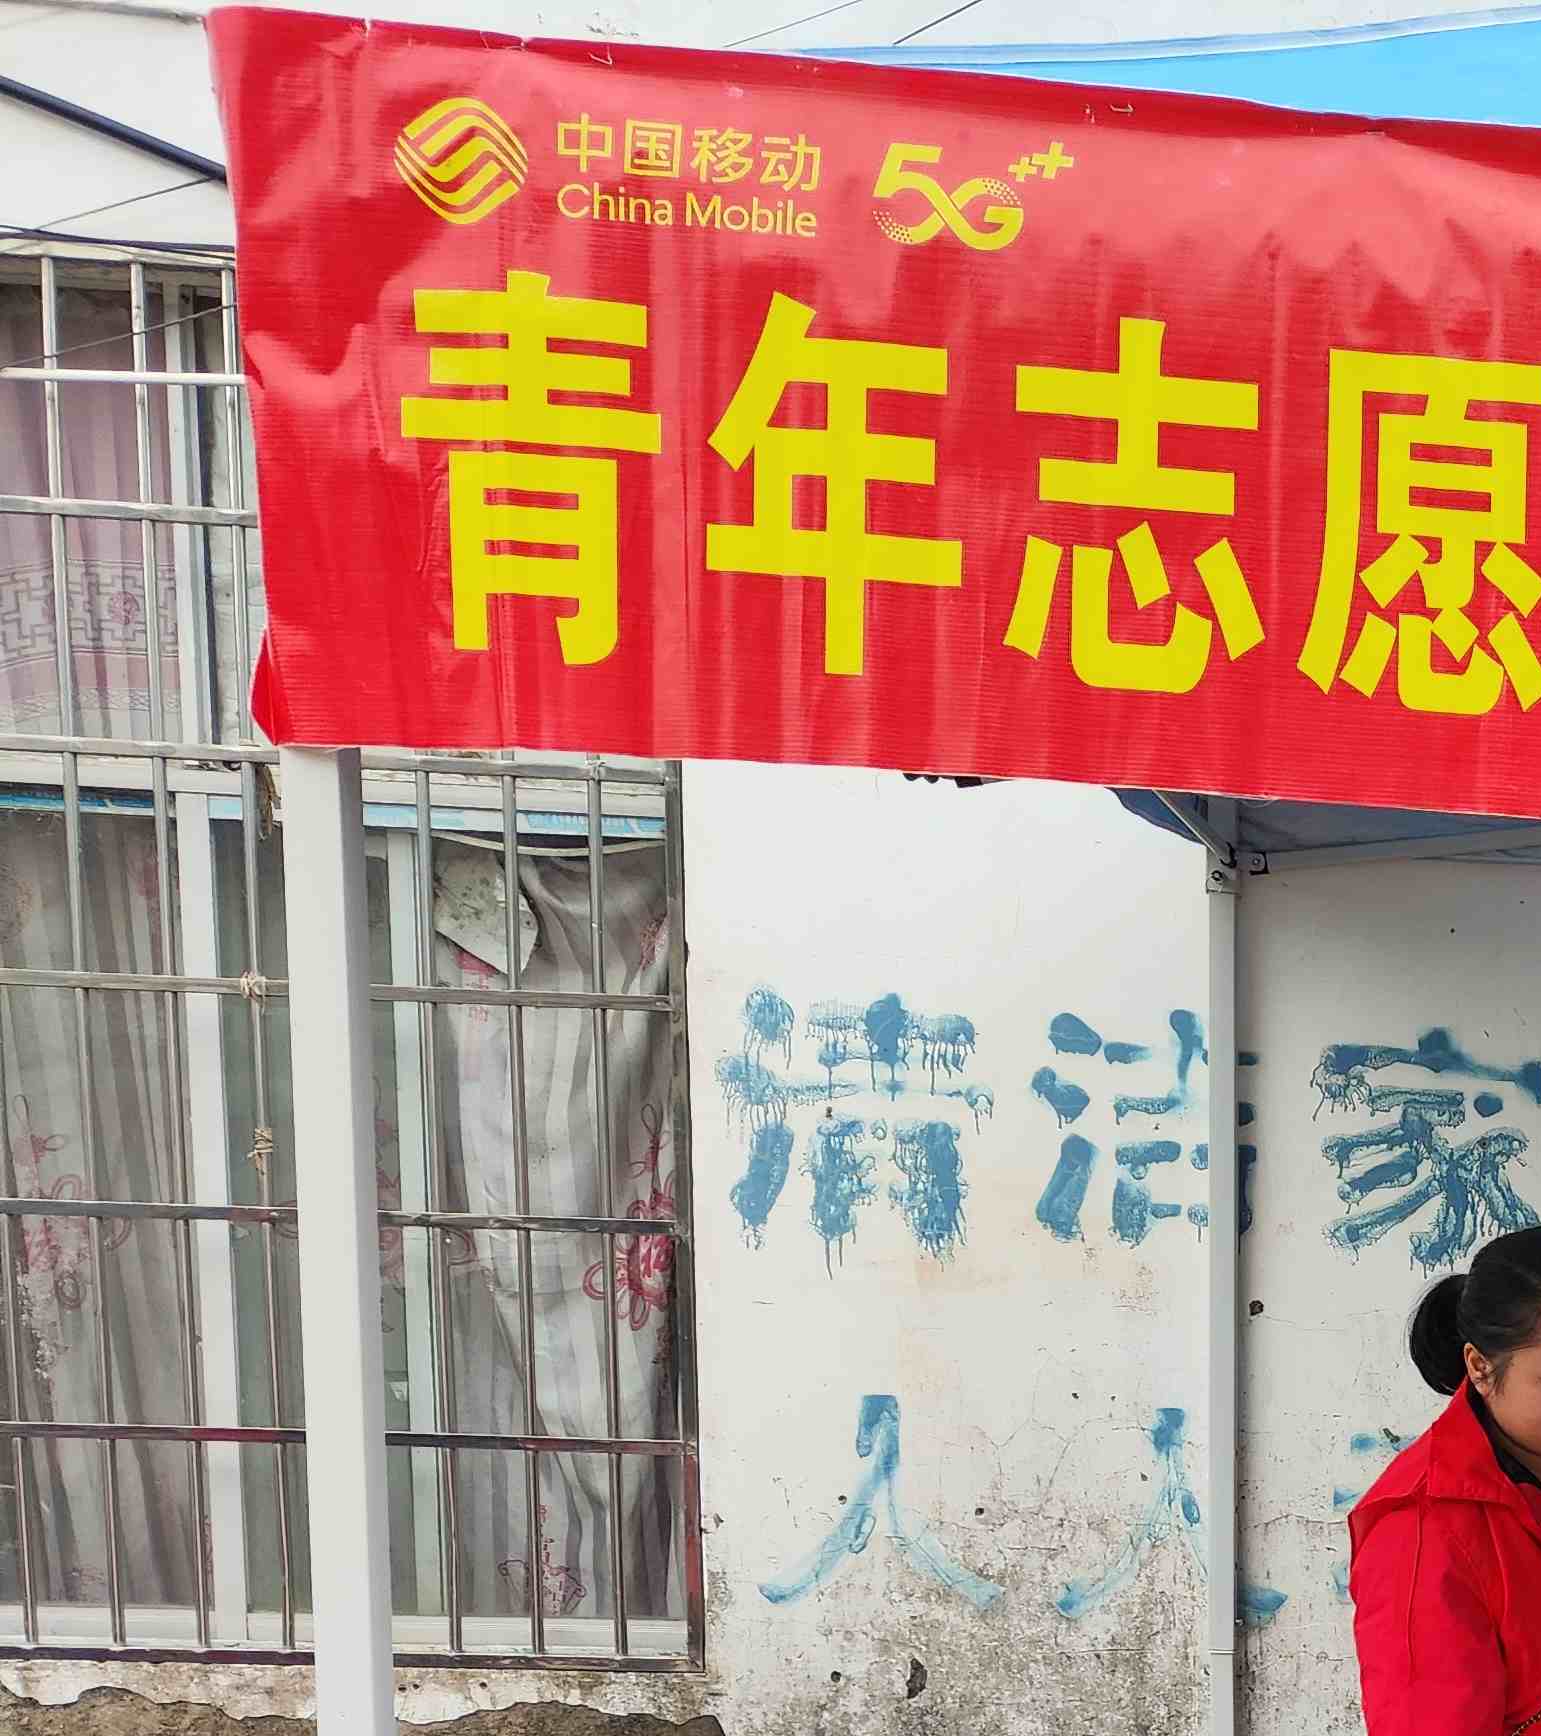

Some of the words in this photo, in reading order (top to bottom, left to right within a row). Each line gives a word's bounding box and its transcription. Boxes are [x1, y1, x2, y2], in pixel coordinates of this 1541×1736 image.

[555, 112, 823, 193] 中国移动
[555, 183, 675, 227] China
[683, 191, 819, 240] Mobile
